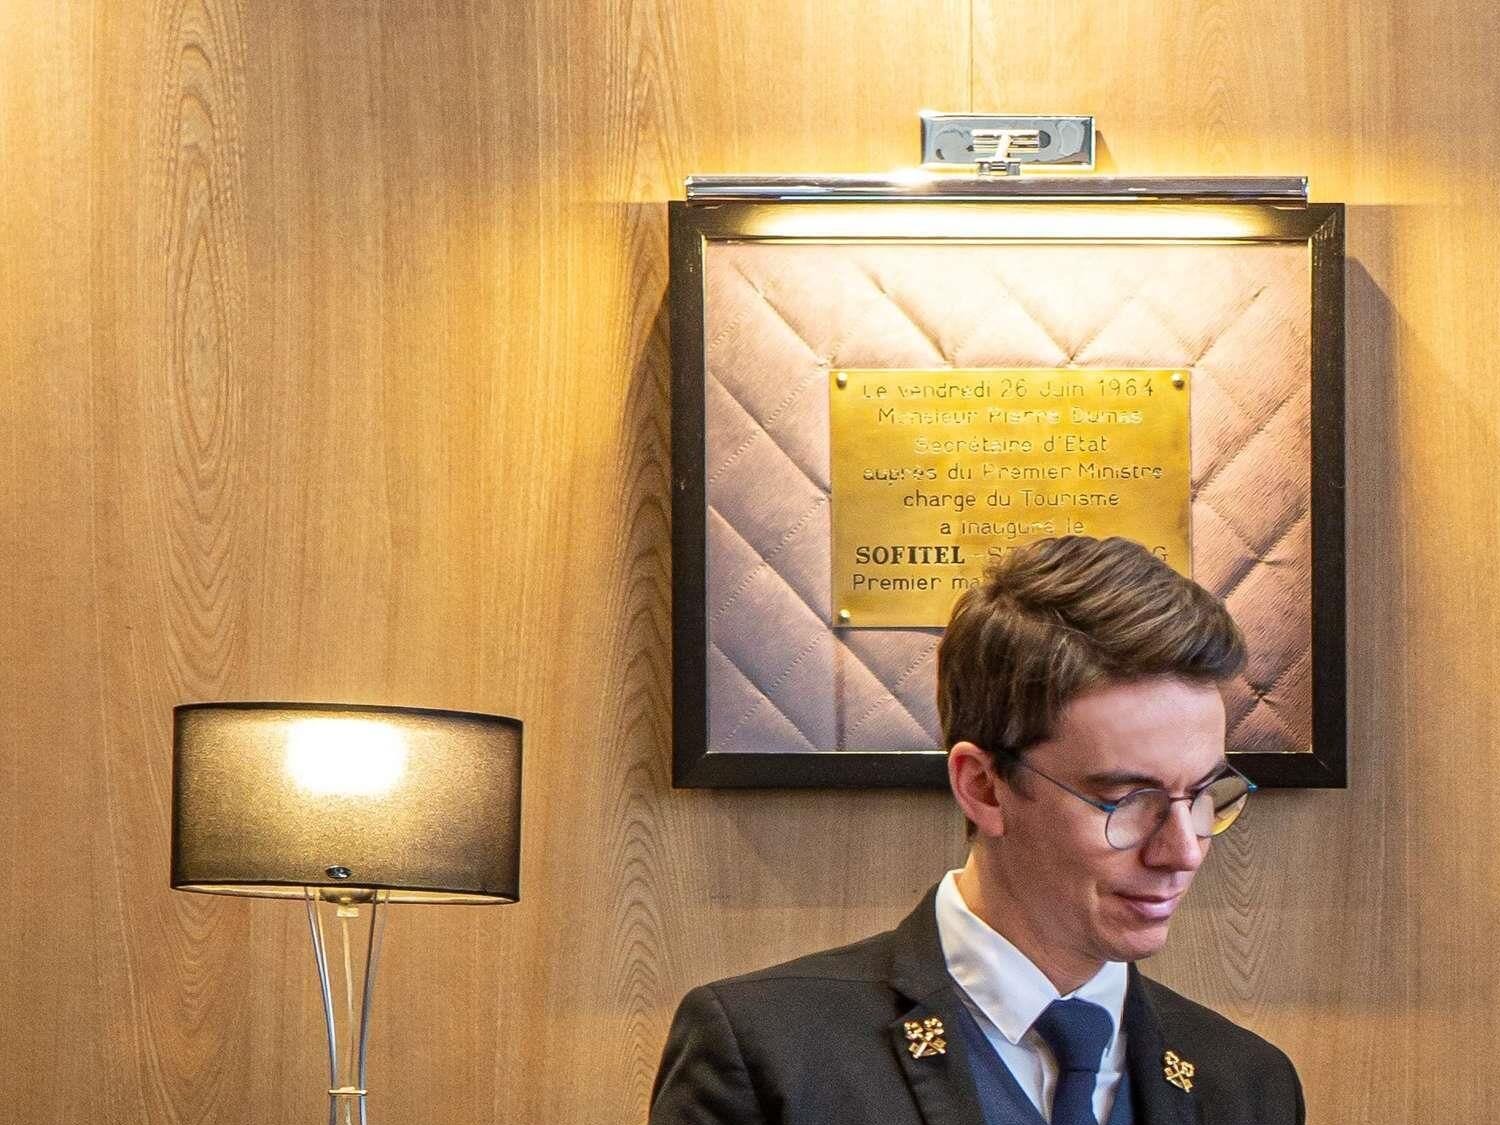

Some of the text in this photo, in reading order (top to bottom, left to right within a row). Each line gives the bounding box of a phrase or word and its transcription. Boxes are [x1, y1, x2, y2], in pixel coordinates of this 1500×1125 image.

[863, 377, 1154, 399] Le vendredi 26 Juin 1964
[947, 464, 973, 481] du
[982, 463, 1072, 481] Premier
[1078, 463, 1163, 480] Ministre
[987, 489, 1011, 507] du
[1019, 489, 1120, 507] Tourisme
[1067, 513, 1084, 534] le
[855, 545, 965, 565] SOFITEL
[852, 574, 943, 593] Premier
